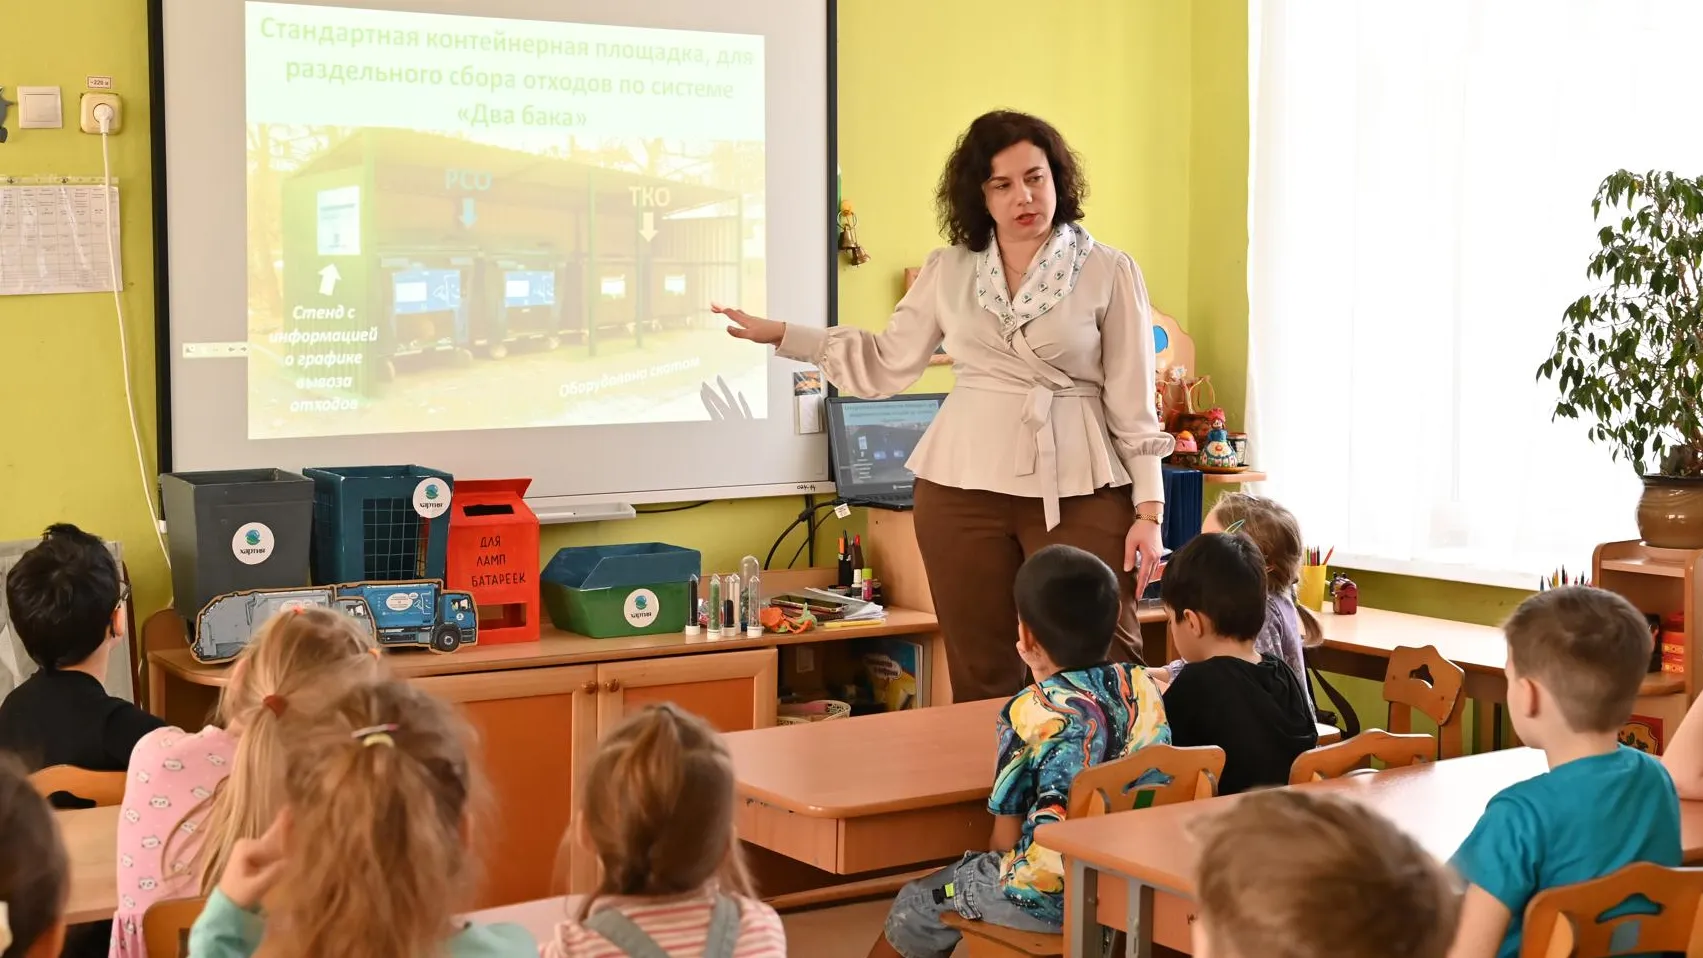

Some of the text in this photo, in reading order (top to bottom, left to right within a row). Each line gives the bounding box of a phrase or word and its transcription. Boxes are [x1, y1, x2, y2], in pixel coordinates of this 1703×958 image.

[260, 17, 754, 67] Стандартная контейнерная площадка, для
[286, 61, 734, 99] раздельного сбора отходов по системе
[457, 103, 587, 127] «Два бака»
[444, 168, 493, 191] РСО
[628, 185, 671, 207] ТКО
[292, 305, 356, 320] Стенд с
[269, 326, 378, 345] информацией
[284, 350, 363, 368] о графике
[295, 376, 353, 389] вывоза
[289, 397, 359, 412] отходов
[480, 535, 501, 548] ДЛЯ
[476, 554, 506, 567] ЛАМП
[471, 571, 526, 587] БАТАРЕЕК
